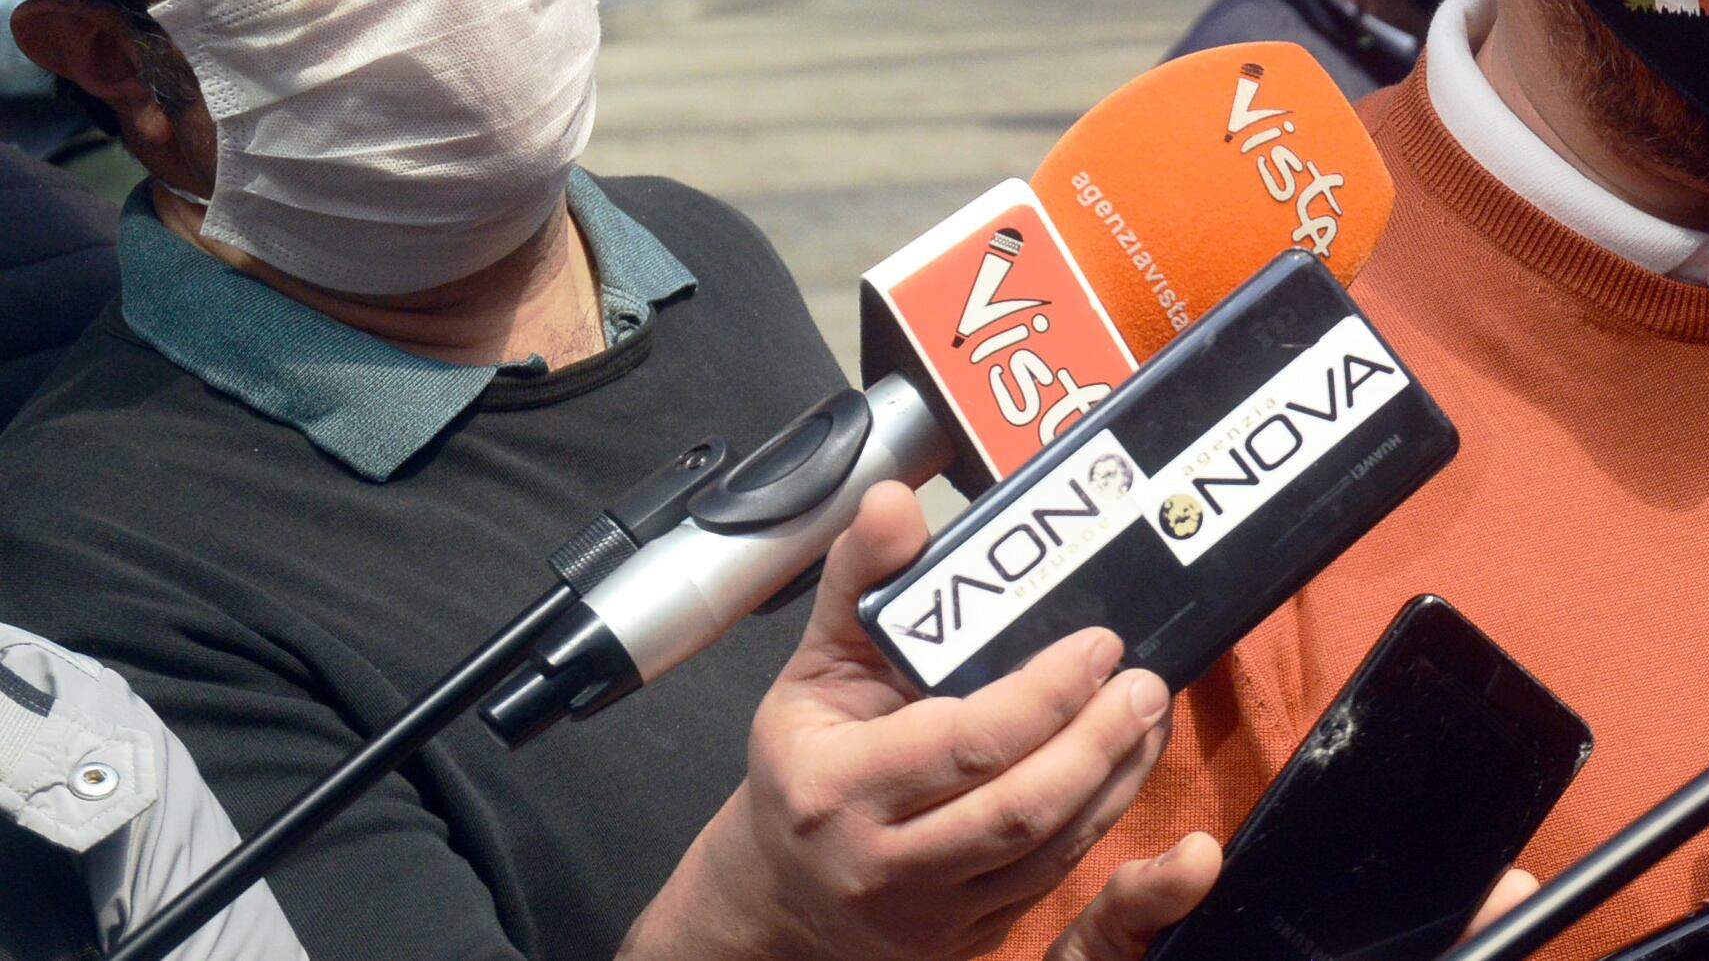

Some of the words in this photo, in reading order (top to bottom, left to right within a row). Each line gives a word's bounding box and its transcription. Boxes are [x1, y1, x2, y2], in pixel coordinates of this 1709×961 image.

[951, 228, 1113, 448] Vist
[1193, 353, 1396, 515] NOVA
[1352, 434, 1402, 480] HUAWEI
[892, 477, 1101, 645] NOVA
